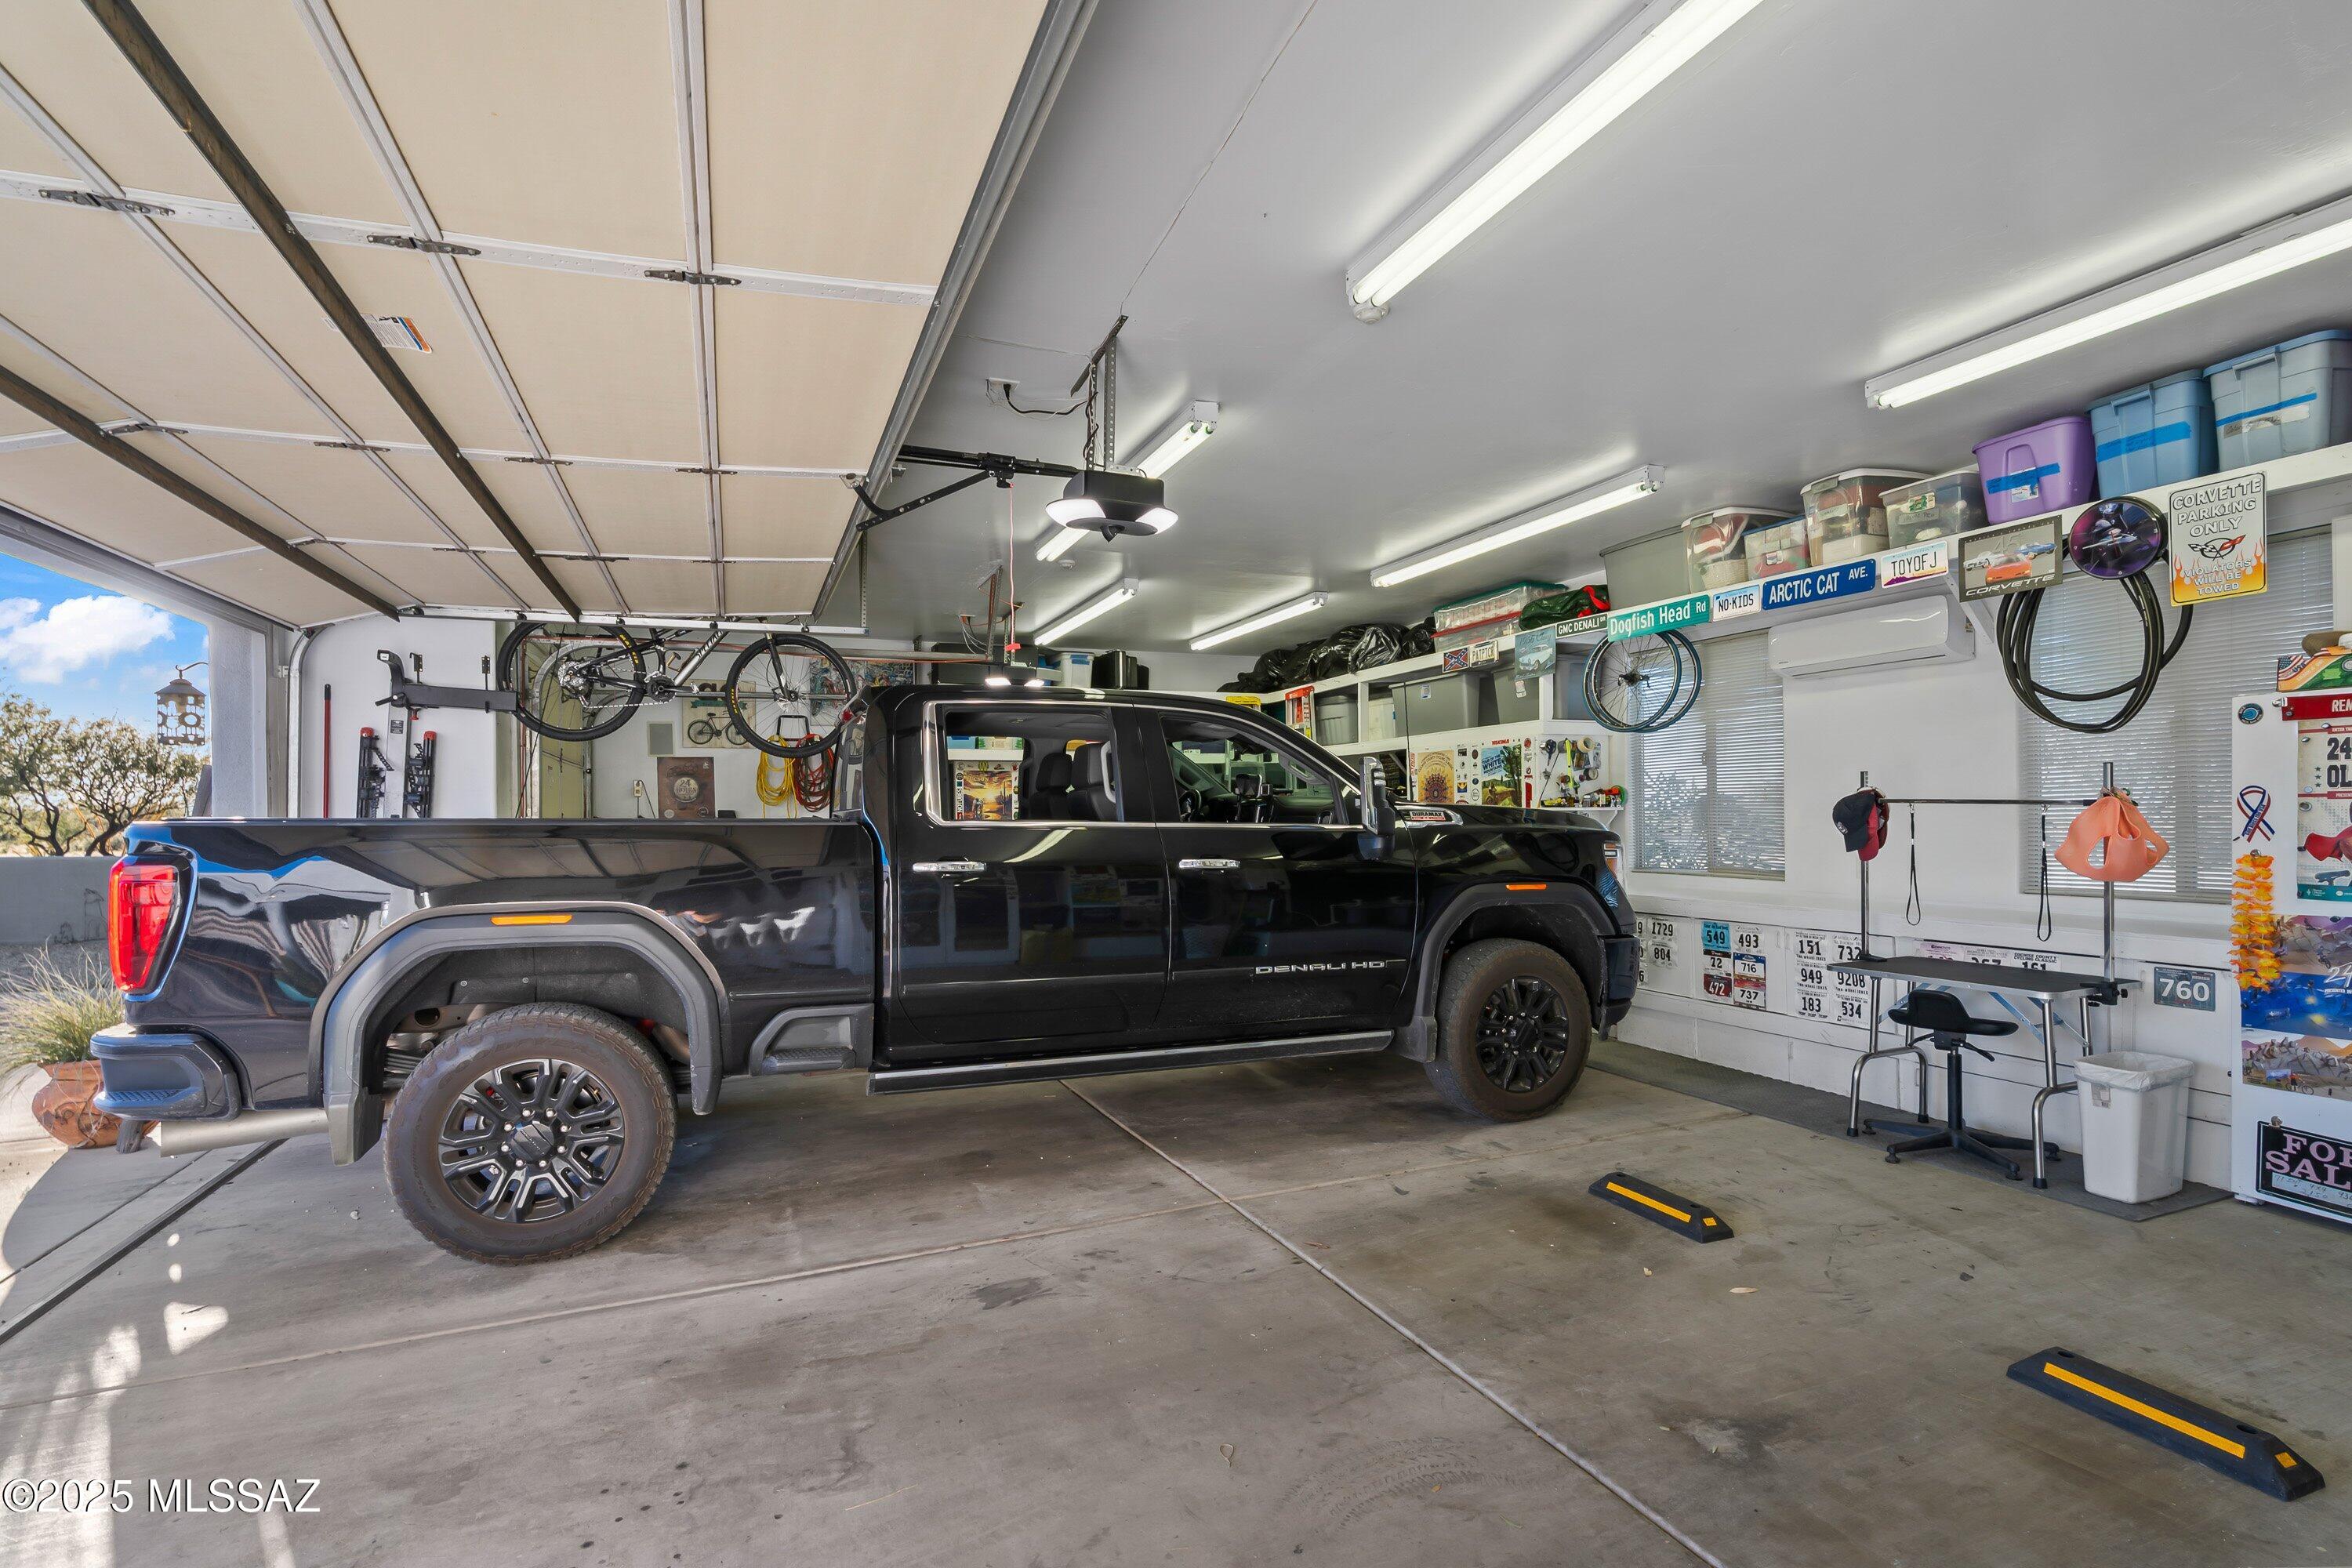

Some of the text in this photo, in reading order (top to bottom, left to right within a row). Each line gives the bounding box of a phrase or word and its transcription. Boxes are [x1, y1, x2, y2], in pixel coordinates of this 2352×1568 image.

[2173, 478, 2262, 510] CORVETTE
[2177, 498, 2256, 524] PARKING
[2190, 516, 2242, 538] ONLY
[2183, 559, 2252, 578] VIOLATORS
[1769, 566, 1868, 604] ARCTIC CAT AVE.
[1965, 573, 2056, 597] CORVETTE
[2194, 572, 2242, 586] WILL BE
[2197, 583, 2240, 596] TOWED
[1558, 623, 1573, 635] GMC
[1573, 617, 1600, 632] DENALI
[1610, 601, 1707, 637] Dogfish Head Rd
[1482, 758, 1502, 771] WHITE
[1651, 921, 1674, 937] 1729
[1706, 930, 1725, 945] 549
[1738, 933, 1759, 949] 493
[1653, 947, 1671, 962] 804
[1798, 939, 1821, 956] 151
[1256, 960, 1385, 975] DENALI HD
[1740, 962, 1757, 973] 716
[1801, 967, 1823, 984] 949
[1709, 981, 1726, 996] 472
[1740, 989, 1759, 1000] 737
[2159, 978, 2210, 1002] 760
[1802, 996, 1821, 1012] 183
[1841, 1001, 1862, 1018] 534
